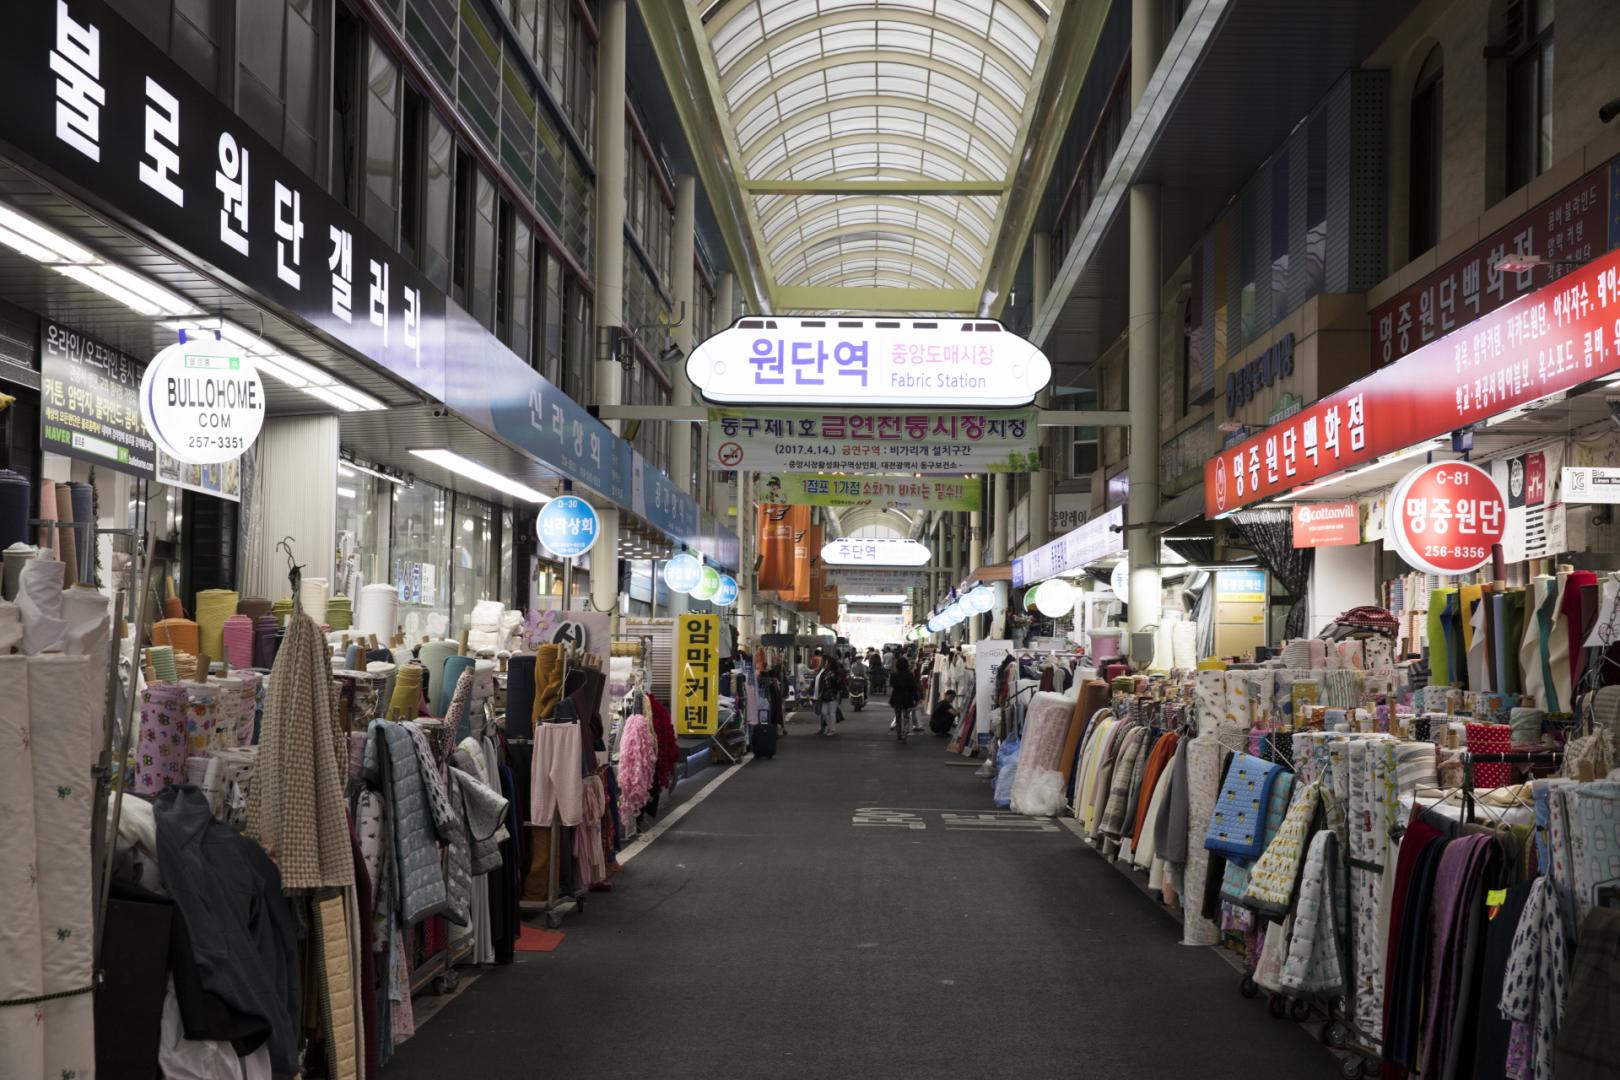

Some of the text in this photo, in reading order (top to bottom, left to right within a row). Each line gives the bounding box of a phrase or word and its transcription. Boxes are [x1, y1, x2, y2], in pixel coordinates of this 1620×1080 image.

[1379, 226, 1534, 362] 명중원단백화점
[47, 325, 118, 379] 온라인/오프라인
[119, 354, 135, 387] 동시
[749, 338, 869, 387] 원단역
[891, 343, 995, 366] 중앙도매시장
[1538, 339, 1579, 384] 옥스포드,
[1583, 326, 1609, 369] 콤비,
[891, 373, 986, 389] Fabric Station
[199, 413, 231, 428] COM
[529, 388, 600, 469] 신라상회
[721, 417, 760, 437] 동구
[764, 418, 817, 438] 제1호
[45, 424, 71, 445] NAVER
[189, 436, 243, 449] 257-3351
[1233, 393, 1365, 496] 명중원단백화점
[775, 444, 972, 457] (2017.4.14.) 금연구역 비가리개 설치구간
[881, 461, 918, 470] 대전광역시
[920, 461, 958, 470] 동구보건소
[1436, 470, 1469, 485] C-81
[803, 480, 829, 494] 1점포
[863, 482, 894, 496] 소화기
[899, 483, 930, 499] 비치는
[934, 483, 964, 500] 필수!!
[1311, 504, 1354, 520] cottonvill
[1406, 498, 1503, 535] 명중원단
[543, 518, 593, 536] 신라상회
[839, 544, 877, 560] 주단역
[1425, 546, 1485, 558] 256-8356
[684, 619, 713, 730] 암막커텐
